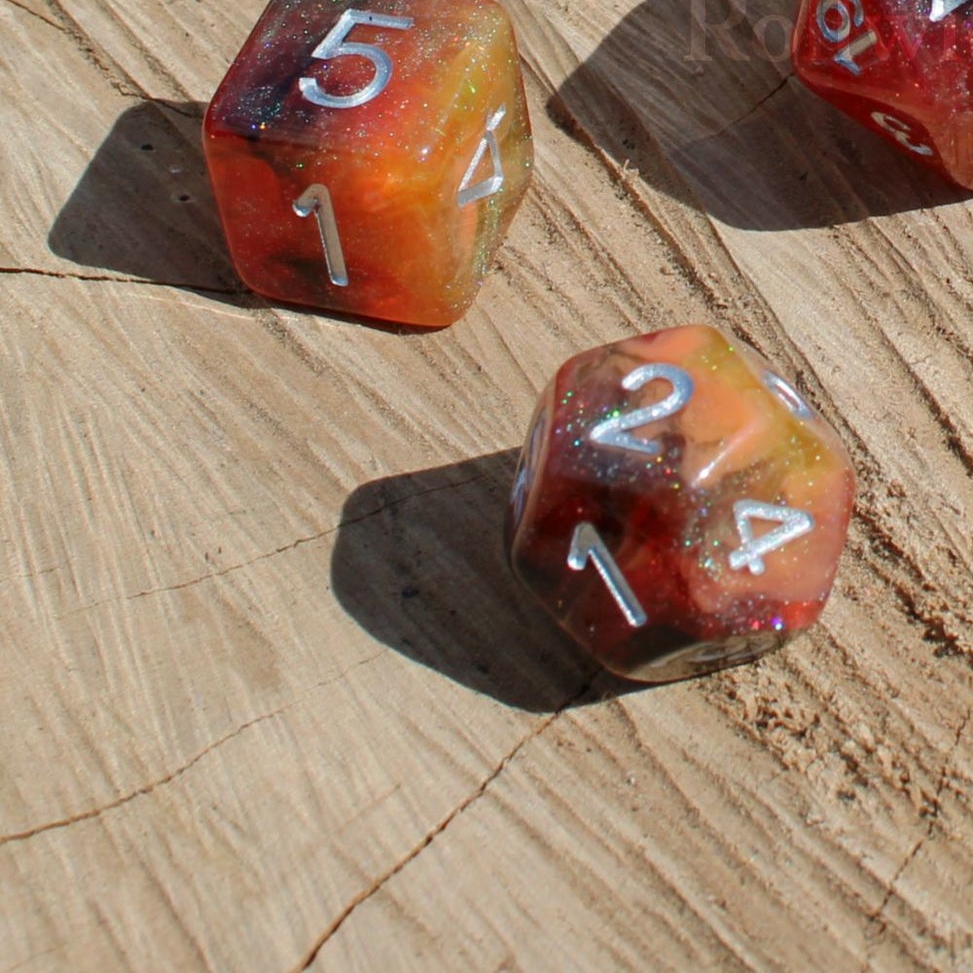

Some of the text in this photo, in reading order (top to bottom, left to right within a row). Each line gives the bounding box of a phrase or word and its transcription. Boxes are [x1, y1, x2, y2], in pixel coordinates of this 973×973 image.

[298, 8, 415, 109] 5
[457, 104, 507, 208] 4
[292, 183, 349, 287] 1
[590, 362, 695, 455] 2
[566, 521, 648, 627] 1
[728, 498, 815, 576] 4
